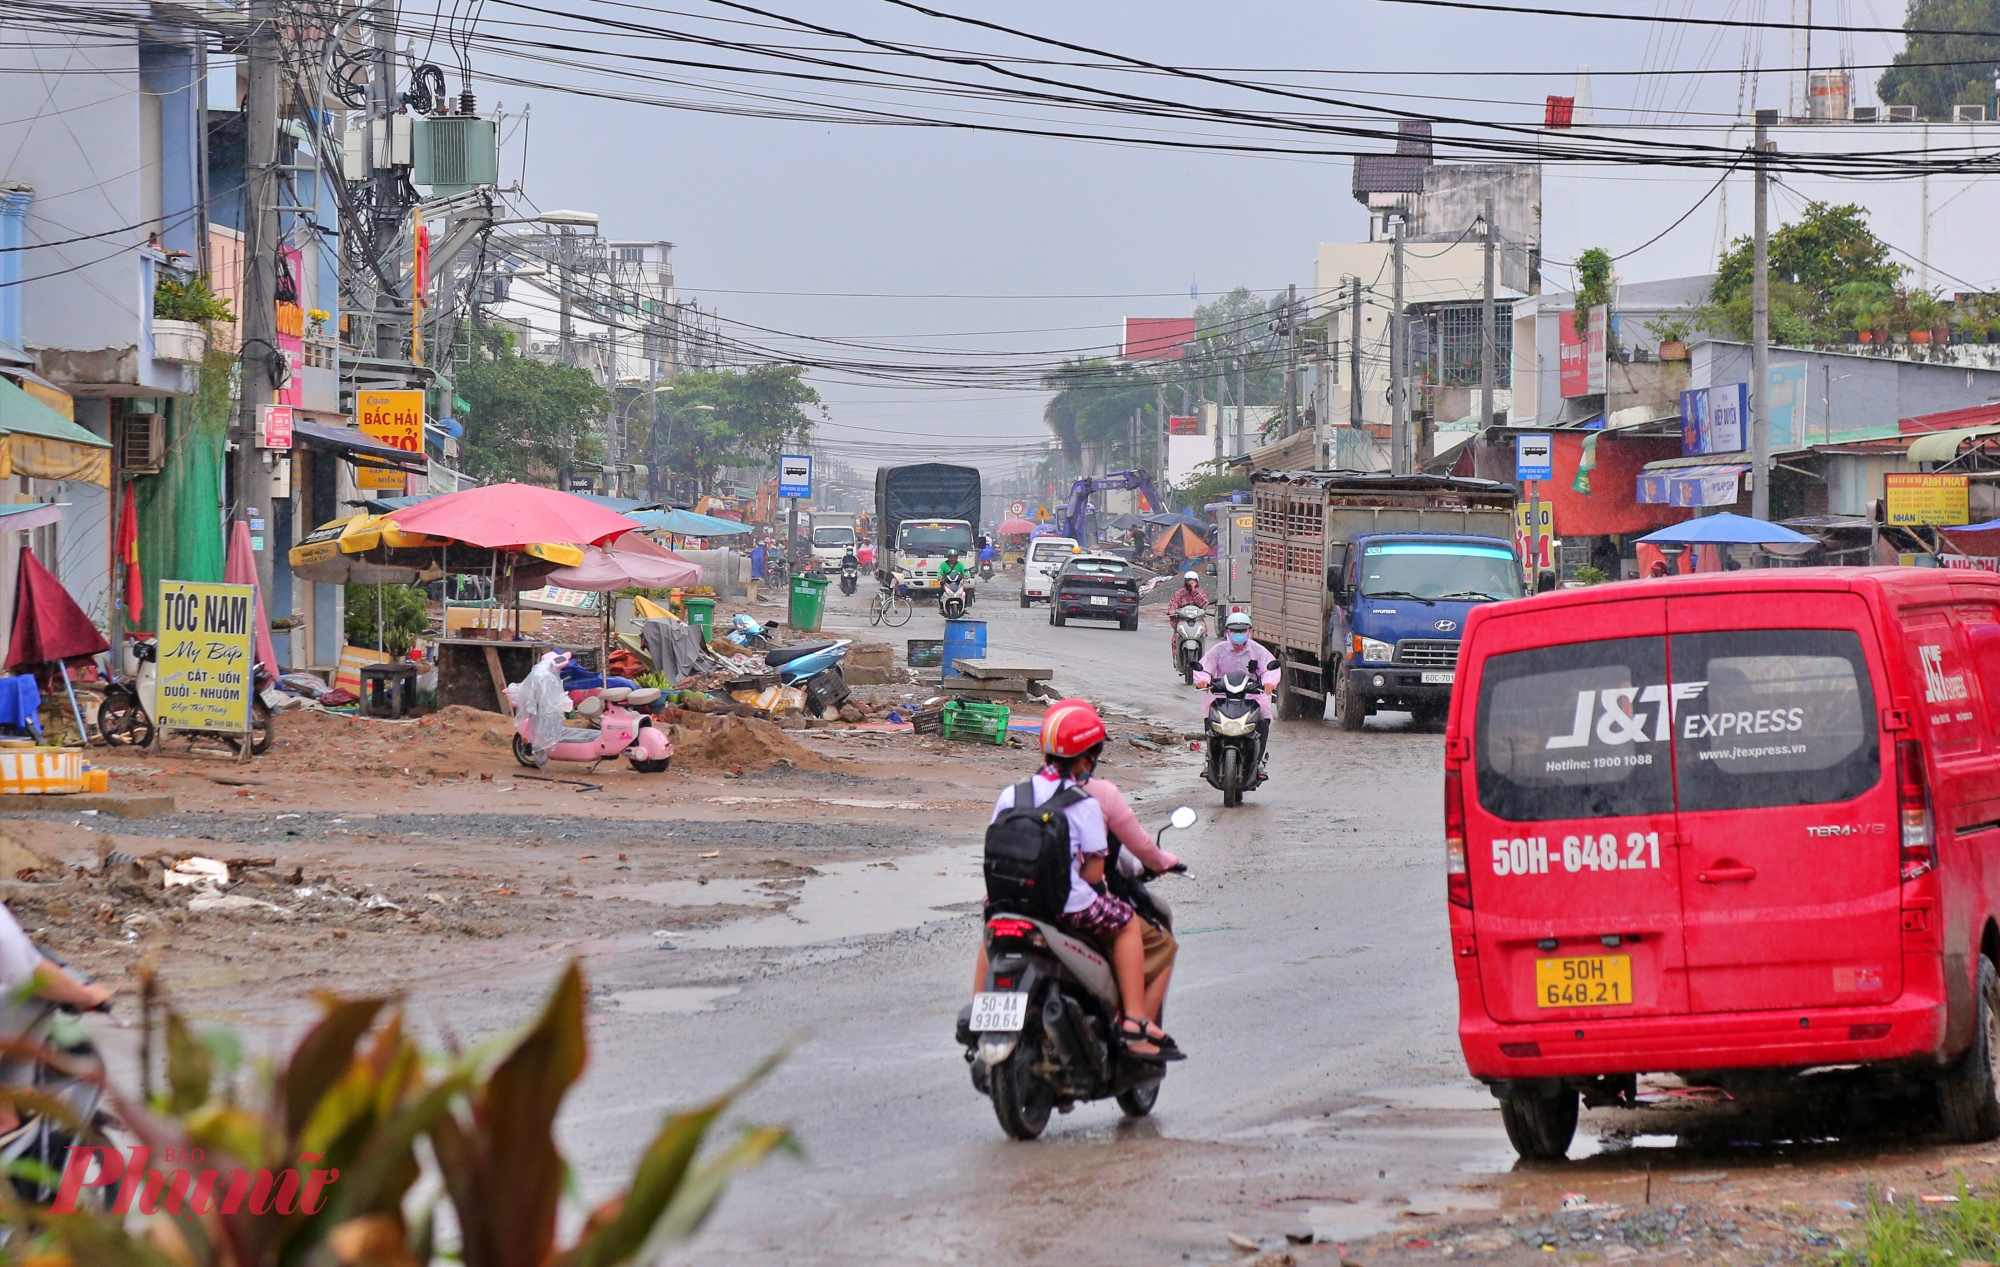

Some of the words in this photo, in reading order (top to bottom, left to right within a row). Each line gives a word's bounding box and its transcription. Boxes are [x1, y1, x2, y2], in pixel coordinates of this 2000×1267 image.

[364, 407, 390, 425] BẮC
[394, 409, 418, 426] HẢI
[1922, 477, 1941, 487] ANH
[165, 585, 198, 632] TÓC
[204, 595, 247, 634] NAM
[163, 641, 201, 663] My
[218, 670, 240, 684] UỐN
[1918, 645, 1948, 704] J&T
[1546, 681, 1709, 755] J&T
[1684, 708, 1804, 738] EXPRESS
[1700, 744, 1807, 760] www.jtexpress.vn
[1546, 759, 1590, 772] Hotline:
[1594, 757, 1621, 768] 1900
[1624, 754, 1652, 766] 1088
[1492, 832, 1660, 876] 50H-648.21
[1563, 959, 1604, 980] 50H
[1547, 982, 1620, 1004] 648.21
[981, 997, 1018, 1012] 50-AA
[975, 1014, 1018, 1028] 930.64
